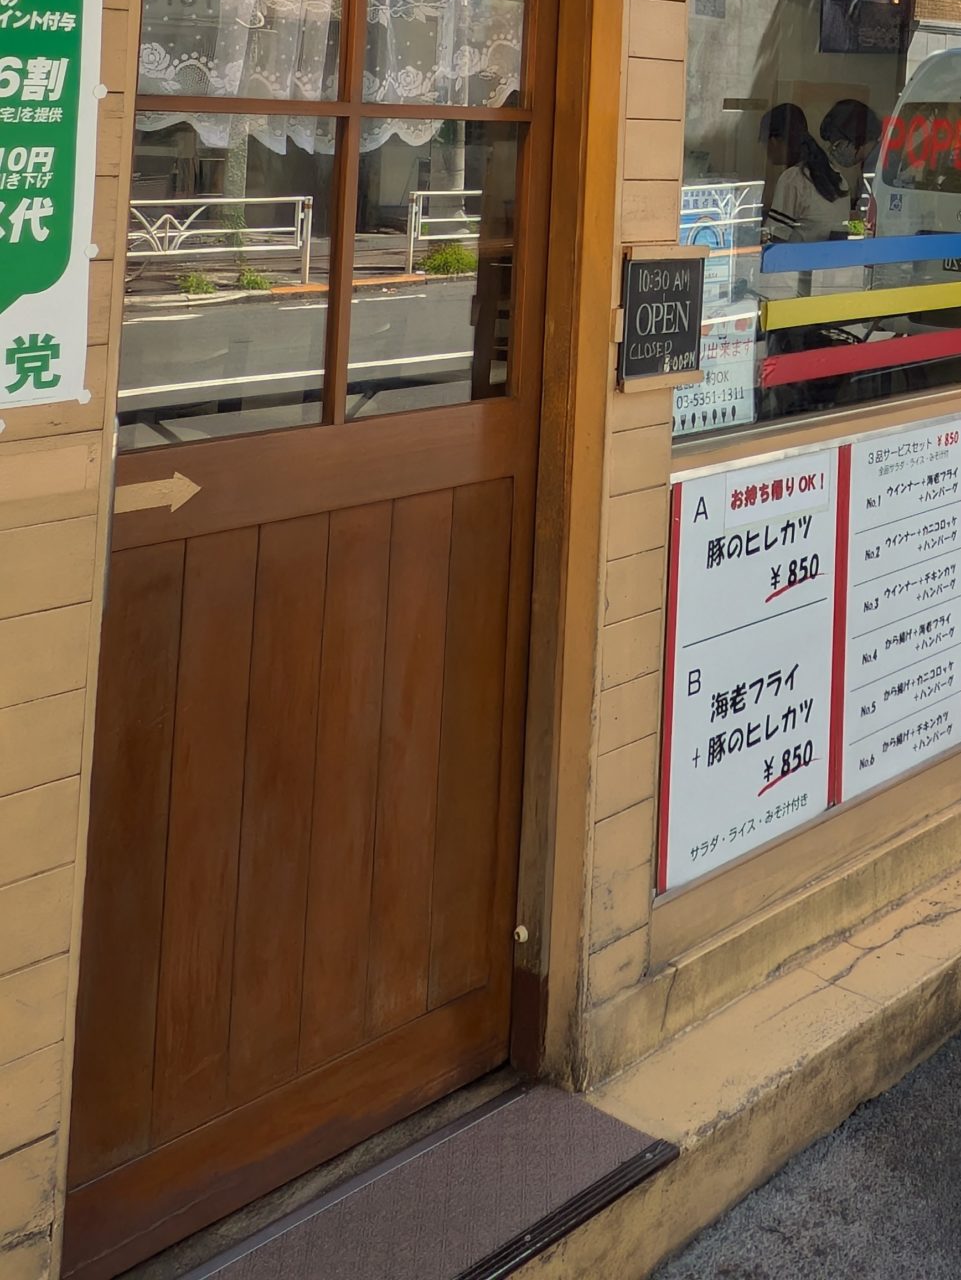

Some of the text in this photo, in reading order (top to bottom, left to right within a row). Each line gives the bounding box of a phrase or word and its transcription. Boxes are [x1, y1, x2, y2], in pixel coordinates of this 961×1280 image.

[638, 268, 690, 292] 10:30 AM
[636, 301, 691, 336] OPEN
[5, 333, 61, 394] 党
[630, 340, 673, 360] CLOSED
[676, 385, 745, 410] 03-5351-1311
[937, 431, 959, 447] ¥850
[693, 496, 708, 523] A
[706, 515, 812, 569] 豚のヒレカツ
[770, 553, 819, 590] ¥850
[688, 669, 701, 697] B
[710, 663, 799, 722] 海老フライ
[763, 740, 813, 782] ¥850
